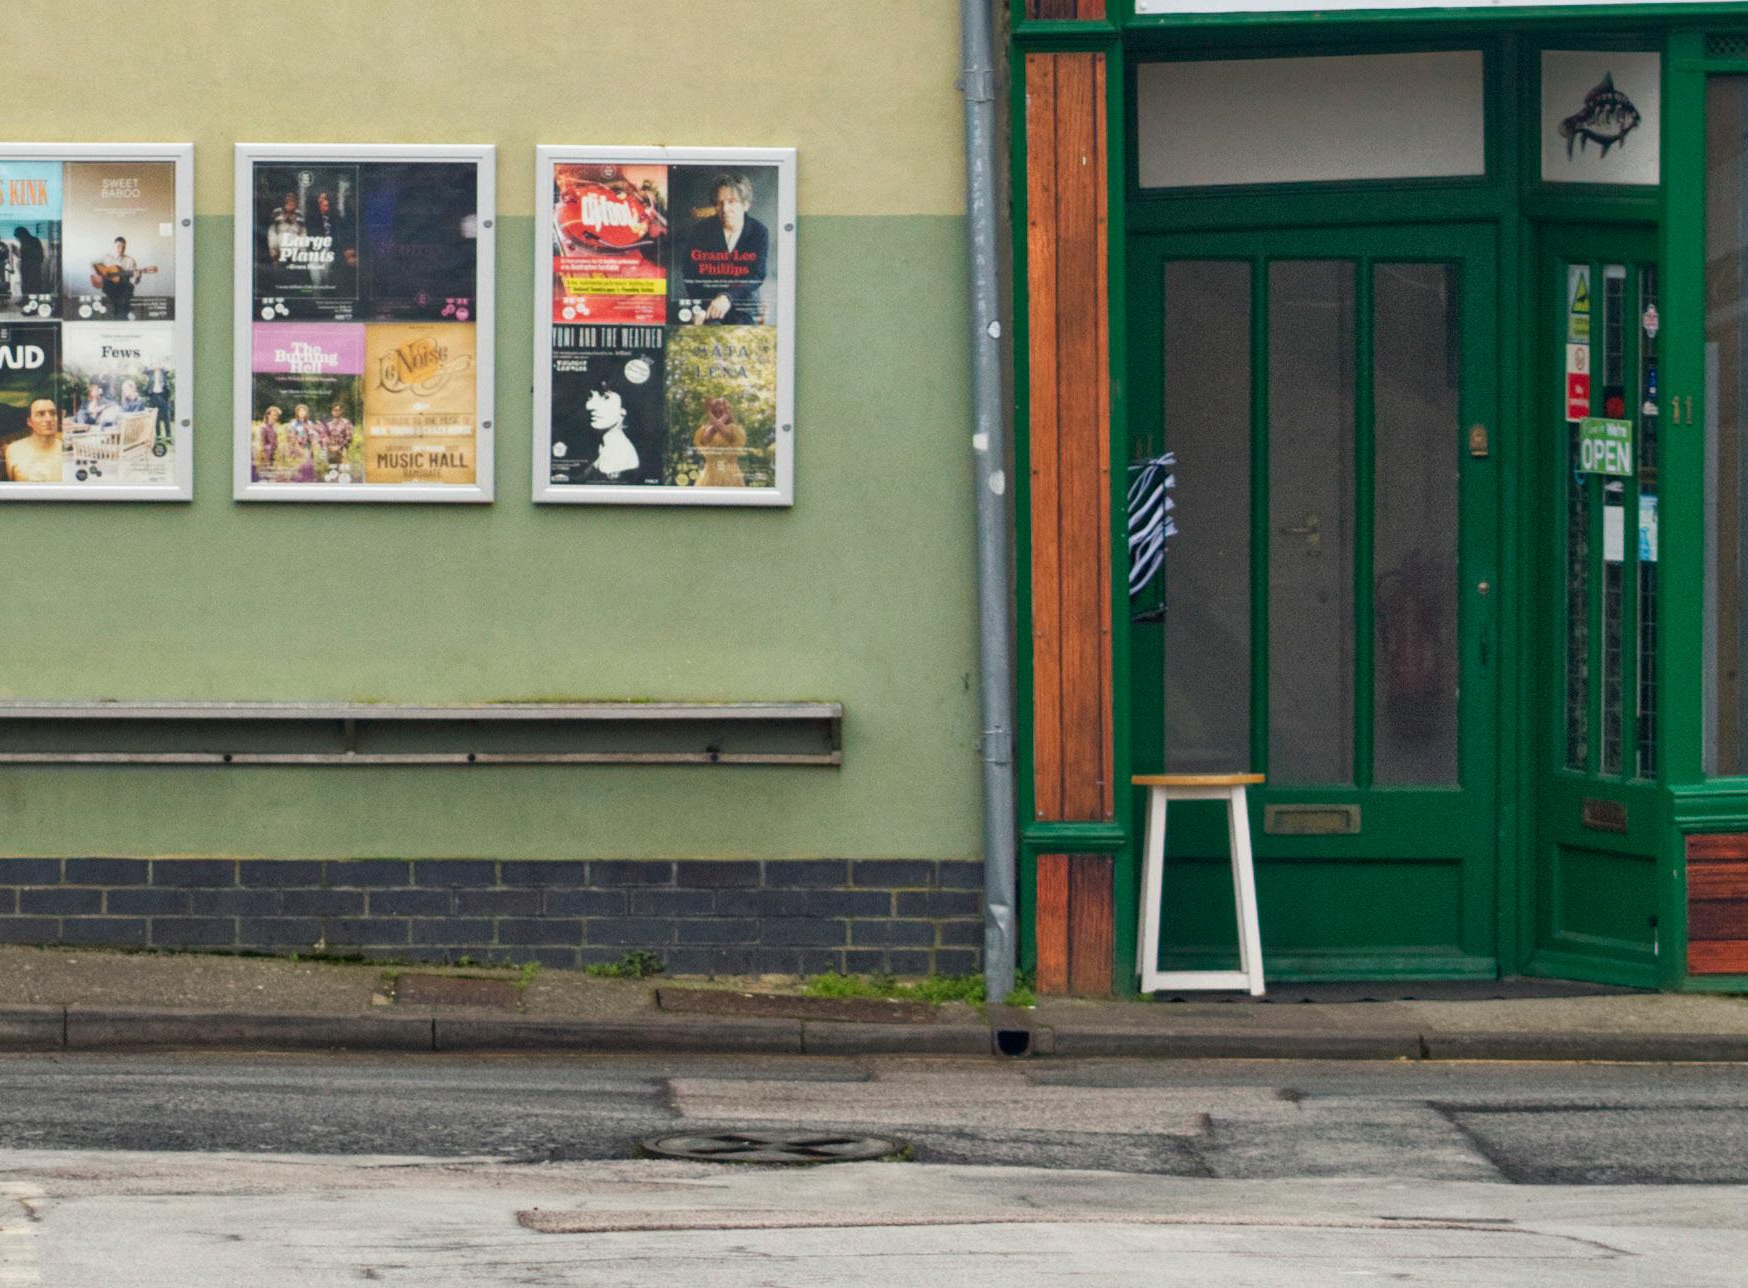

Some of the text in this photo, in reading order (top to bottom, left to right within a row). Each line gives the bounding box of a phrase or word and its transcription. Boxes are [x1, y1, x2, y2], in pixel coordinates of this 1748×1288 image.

[102, 178, 140, 189] SWEET
[8, 178, 49, 207] KINK
[280, 232, 333, 252] Large
[278, 247, 336, 263] Plants
[100, 345, 141, 359] Fews
[291, 341, 322, 354] The
[376, 452, 468, 469] MUSIC HALL
[1580, 438, 1631, 474] OPEN
